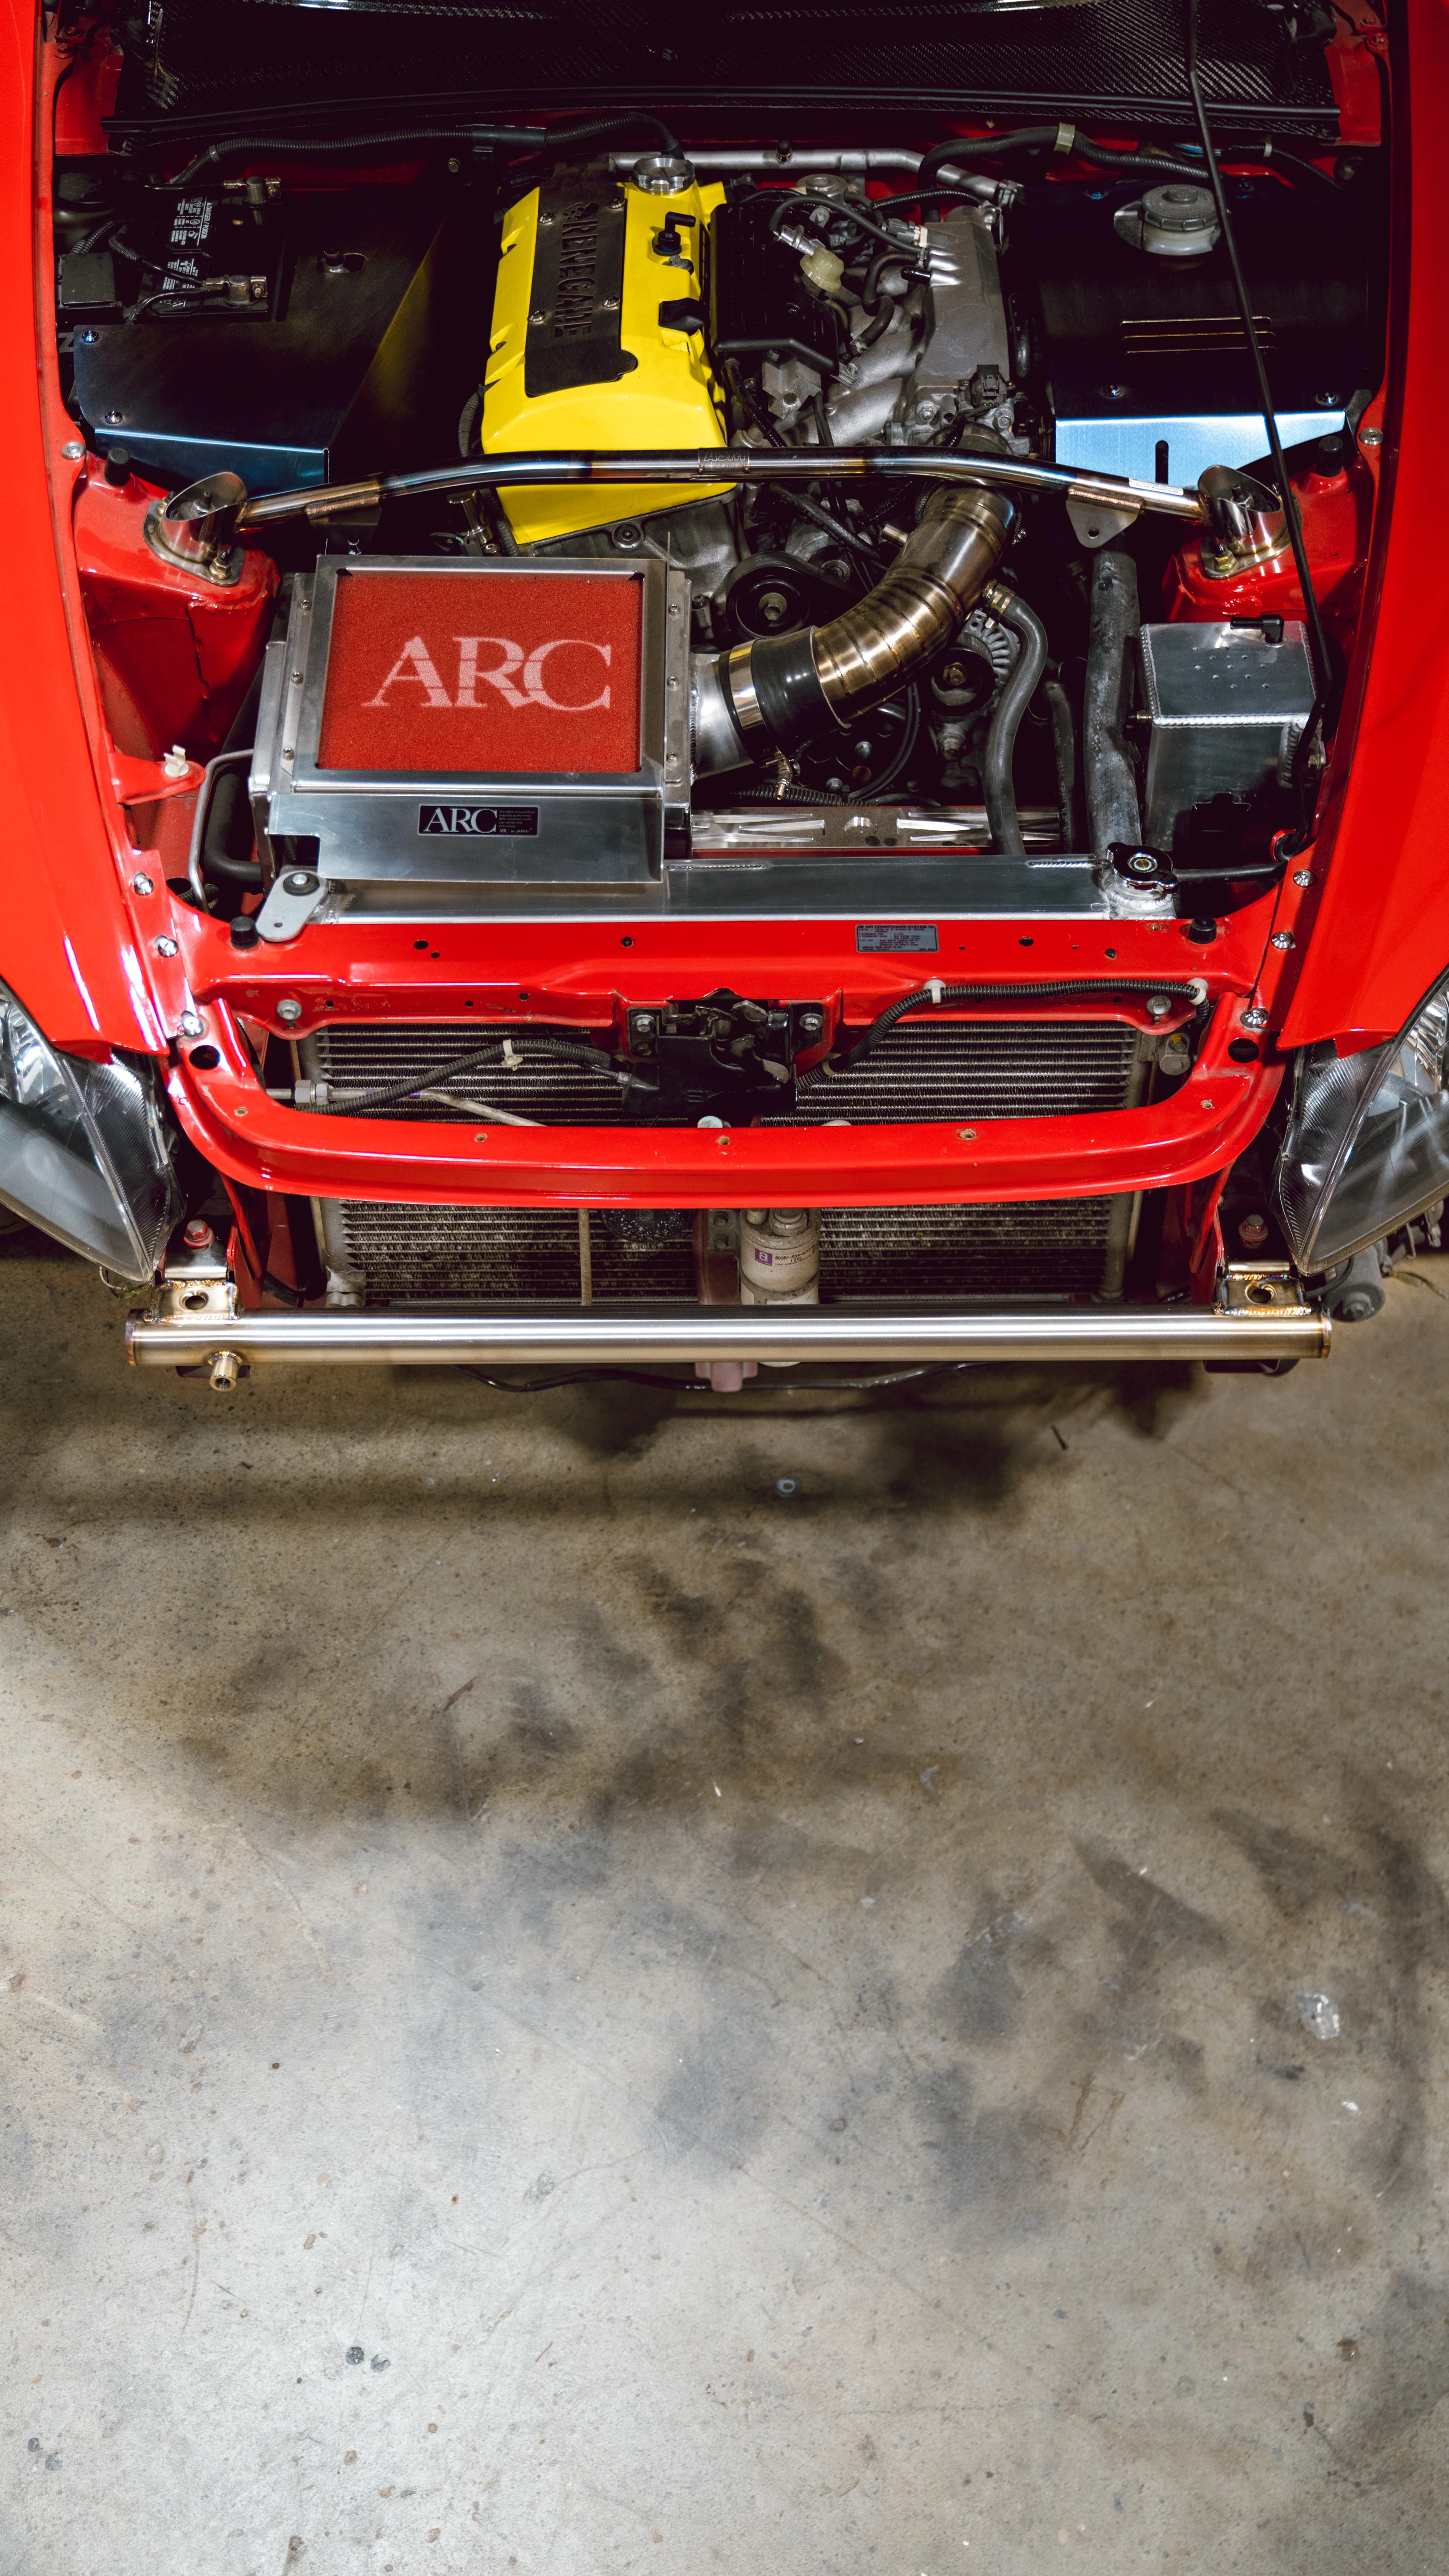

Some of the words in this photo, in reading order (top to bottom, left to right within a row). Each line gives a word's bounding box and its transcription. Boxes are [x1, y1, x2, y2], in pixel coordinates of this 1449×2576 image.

[554, 220, 598, 338] RENEGADE
[361, 636, 611, 711] ARC
[423, 807, 497, 833] ARC
